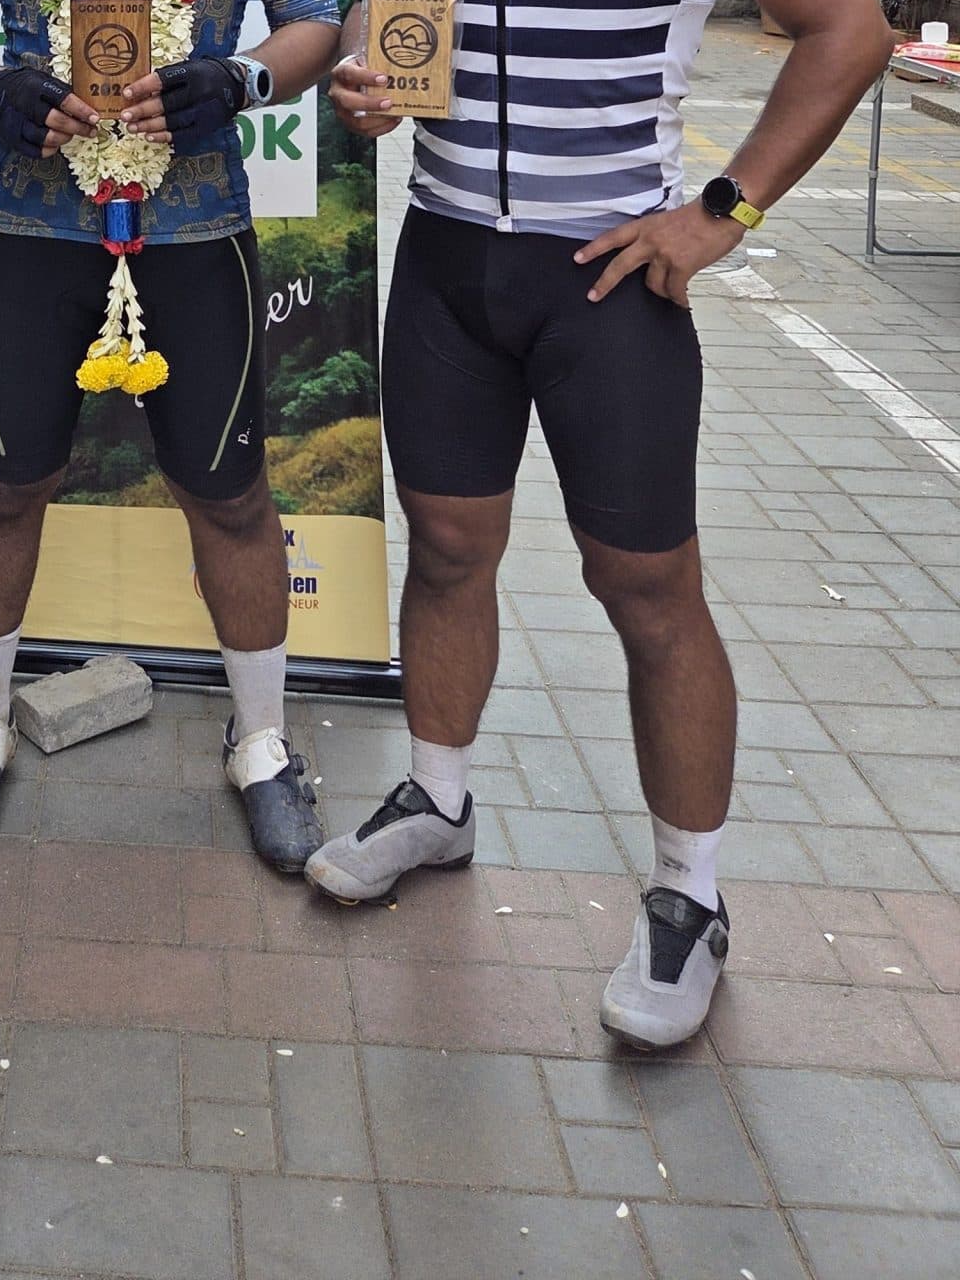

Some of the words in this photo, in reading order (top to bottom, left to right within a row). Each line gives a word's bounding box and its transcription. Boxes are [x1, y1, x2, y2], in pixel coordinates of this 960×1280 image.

[90, 83, 131, 97] 202
[386, 75, 430, 91] 2025
[233, 113, 303, 161] OK
[265, 275, 313, 331] er
[287, 573, 317, 594] ien
[287, 598, 320, 610] NEUR
